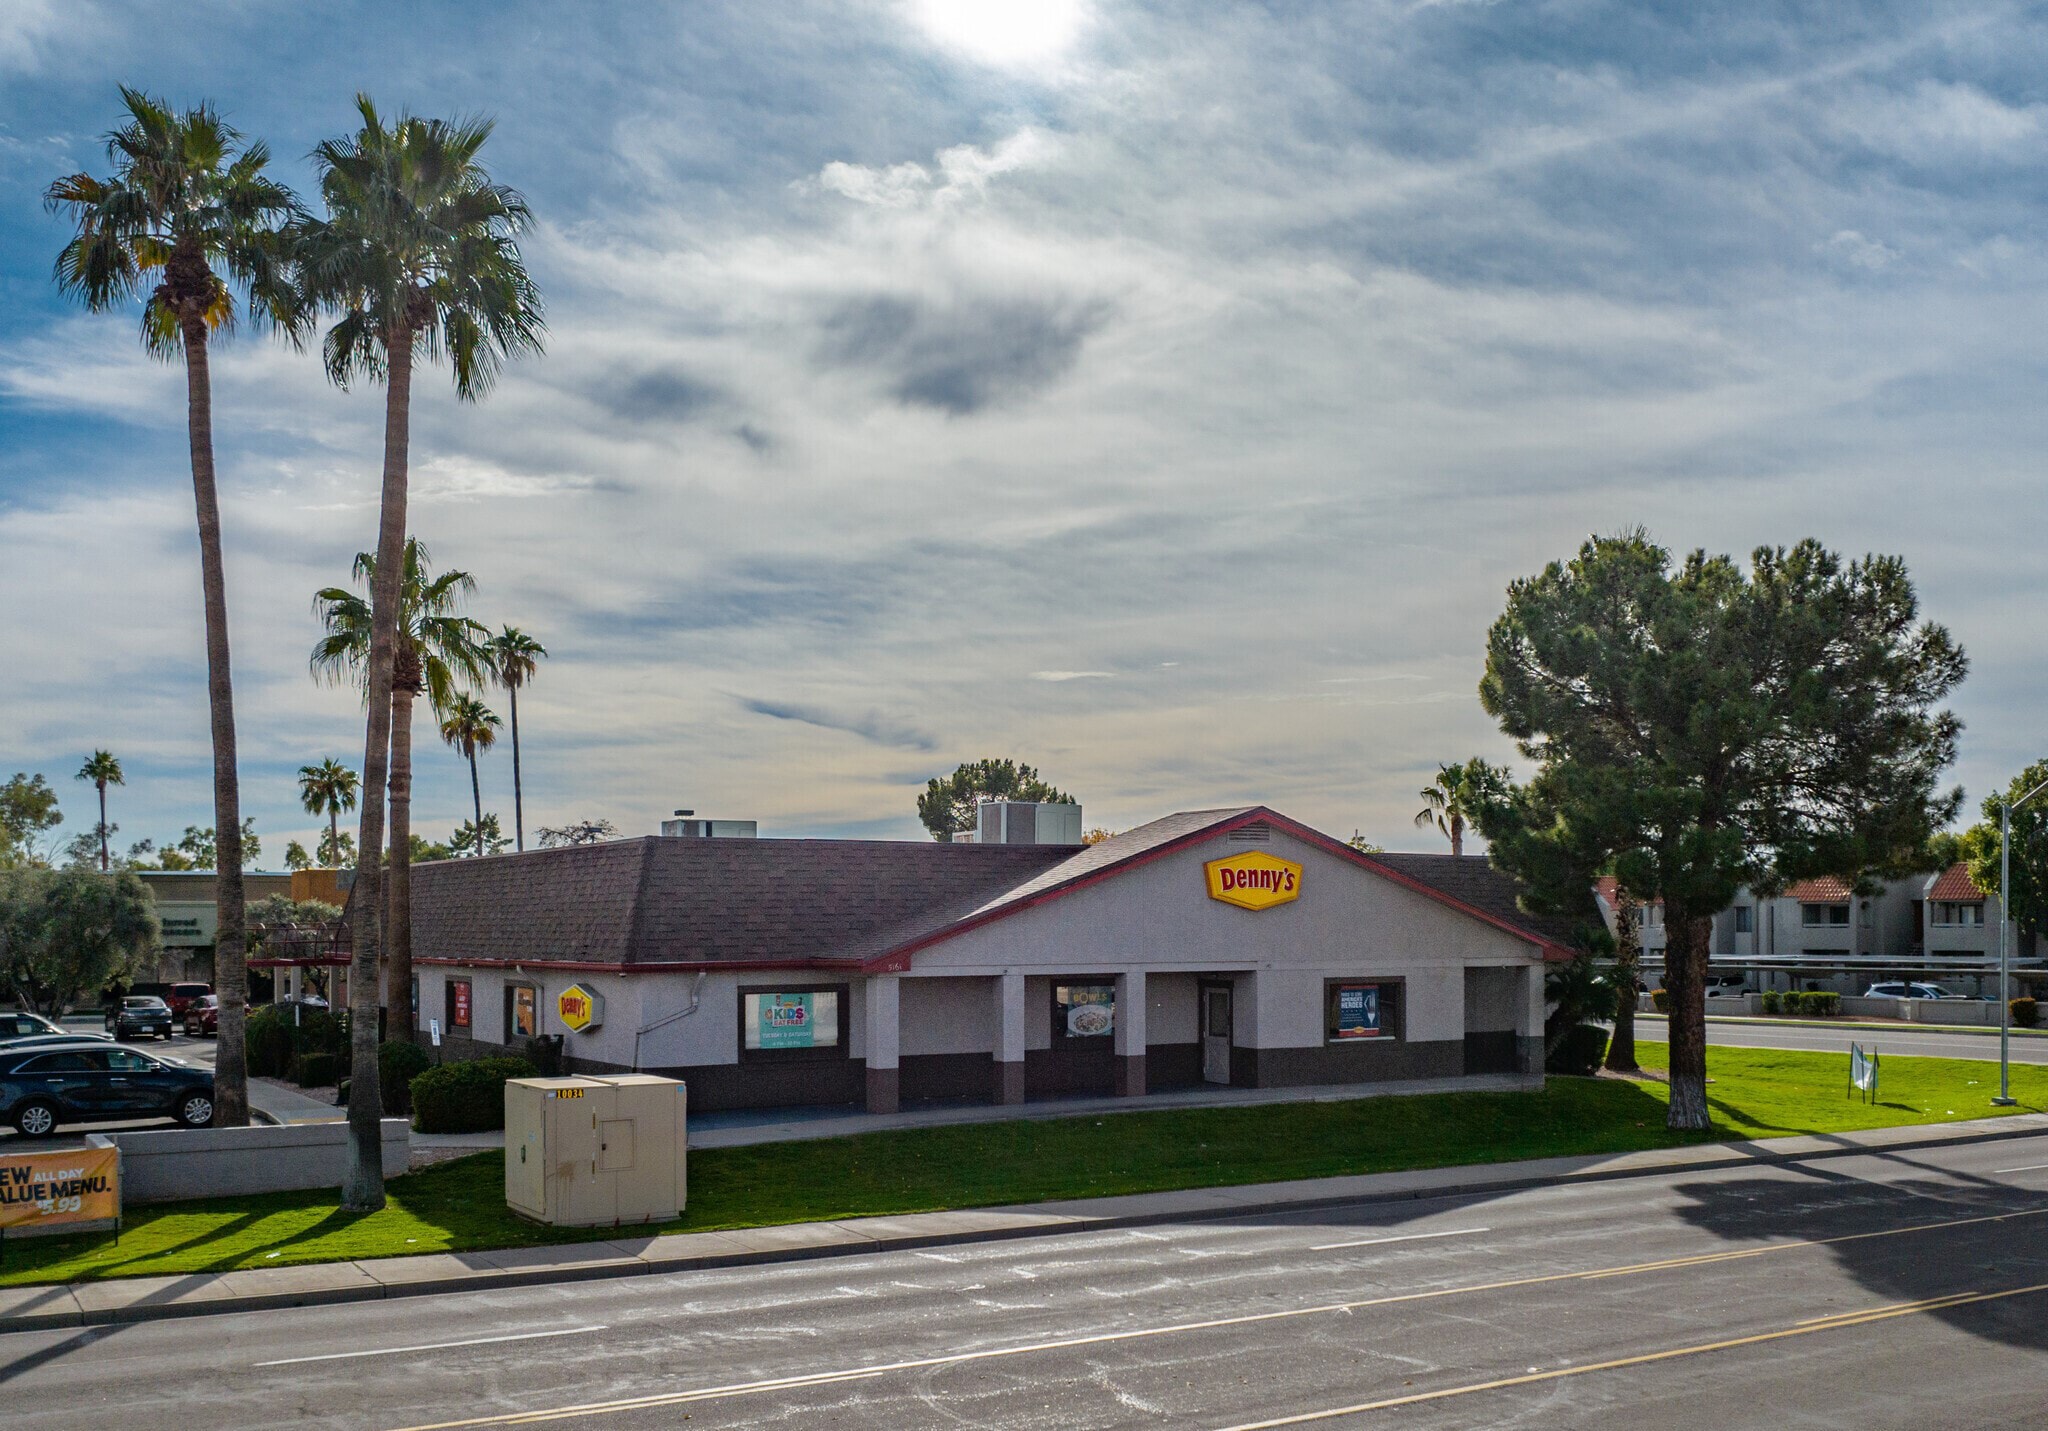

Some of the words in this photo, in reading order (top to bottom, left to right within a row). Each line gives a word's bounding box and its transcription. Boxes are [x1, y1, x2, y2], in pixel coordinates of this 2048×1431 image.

[1219, 867, 1295, 893] Denny's
[561, 996, 585, 1018] Denny's
[774, 1007, 804, 1020] KIDS
[557, 1089, 583, 1099] 10034
[34, 1172, 56, 1182] ALL
[58, 1168, 84, 1180] DAY
[51, 1176, 112, 1199] MENU.
